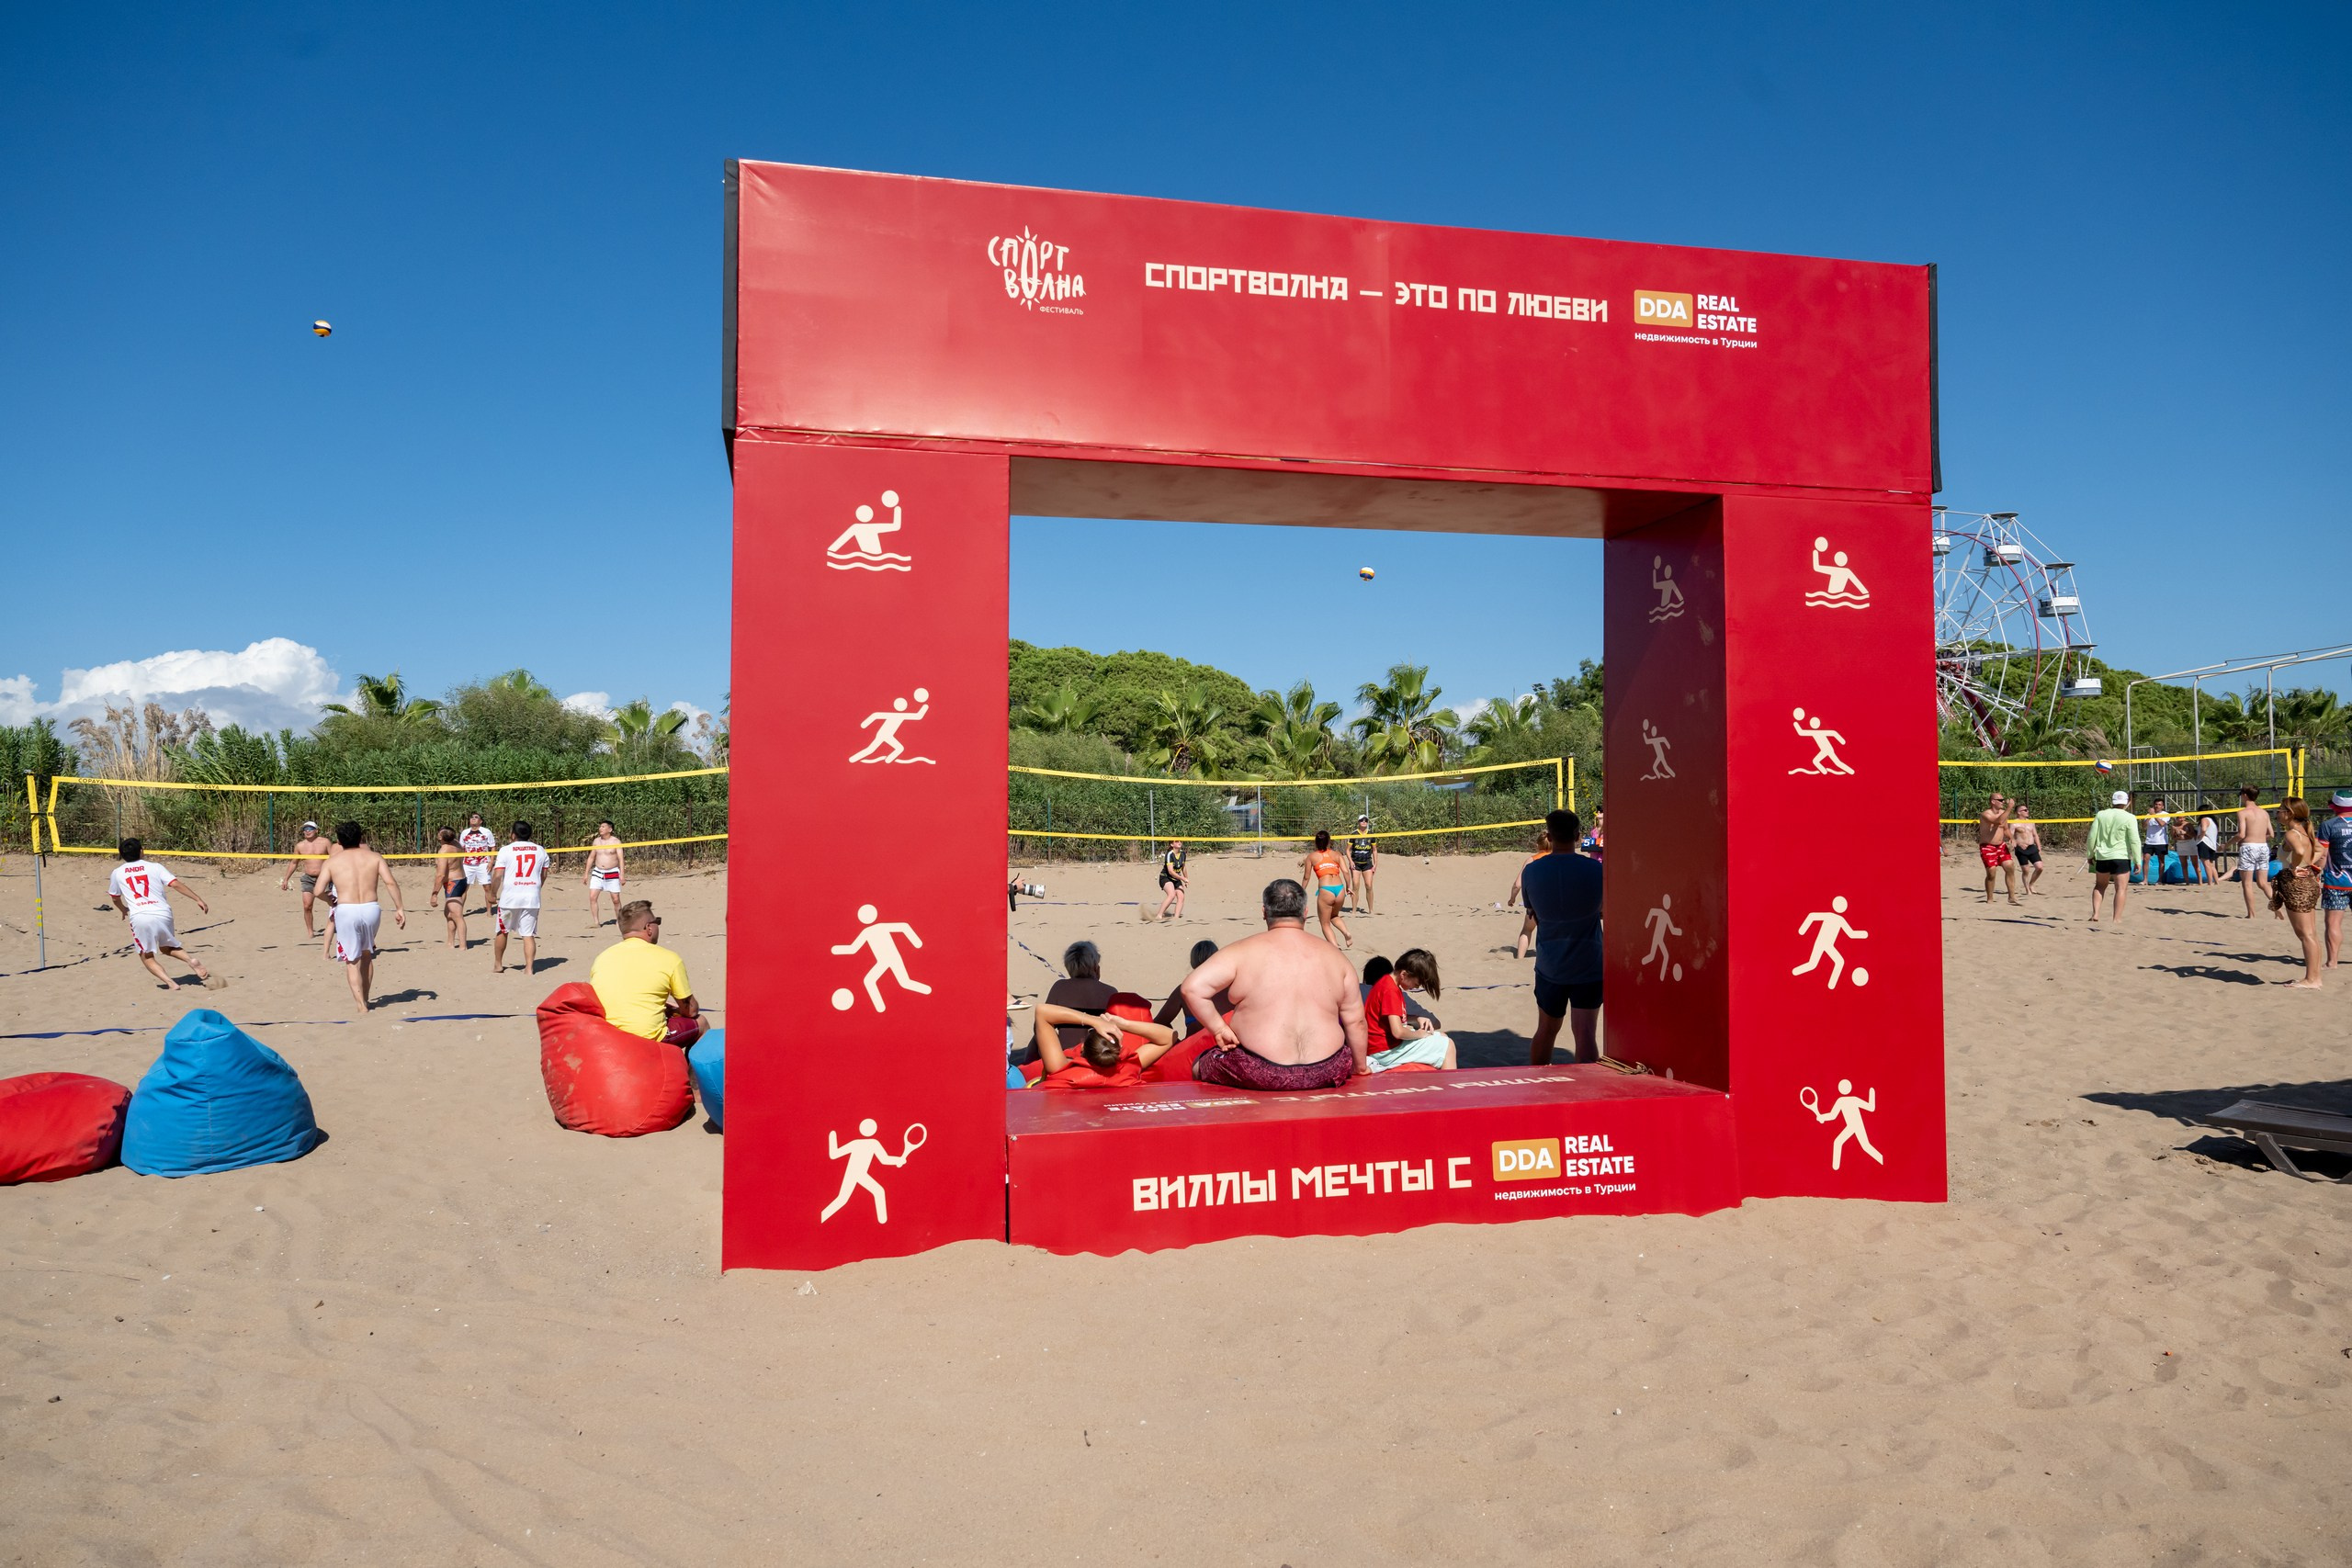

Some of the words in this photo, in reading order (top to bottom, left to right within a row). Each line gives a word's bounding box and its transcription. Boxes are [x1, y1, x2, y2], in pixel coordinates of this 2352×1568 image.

[988, 235, 1069, 272] СПОРТ
[1004, 268, 1086, 300] ВОЛНА
[1146, 262, 1348, 300] СПОРТВОЛНА
[1395, 281, 1448, 310] ЭТО
[1458, 288, 1497, 313] ПО
[1507, 291, 1608, 323] ЛЮБВИ
[1039, 306, 1084, 316] ФЕСТИВАЛЬ
[1639, 298, 1688, 320] DDA
[1697, 294, 1740, 312] REAL
[1697, 313, 1758, 333] ESTATE
[1634, 332, 1711, 345] недвижимость
[1720, 337, 1758, 349] Турции
[515, 853, 536, 878] 17
[125, 874, 150, 899] 17
[1565, 1134, 1613, 1154] REAL
[1498, 1147, 1555, 1172] DDA
[1566, 1156, 1635, 1177] ESTATE
[1133, 1169, 1276, 1212] ВИЛЛЫ
[1291, 1158, 1434, 1200] МЕЧТЫ
[1448, 1156, 1472, 1189] С
[1494, 1185, 1582, 1201] недвижимость
[1585, 1186, 1591, 1194] в
[1594, 1182, 1636, 1195] Турции
